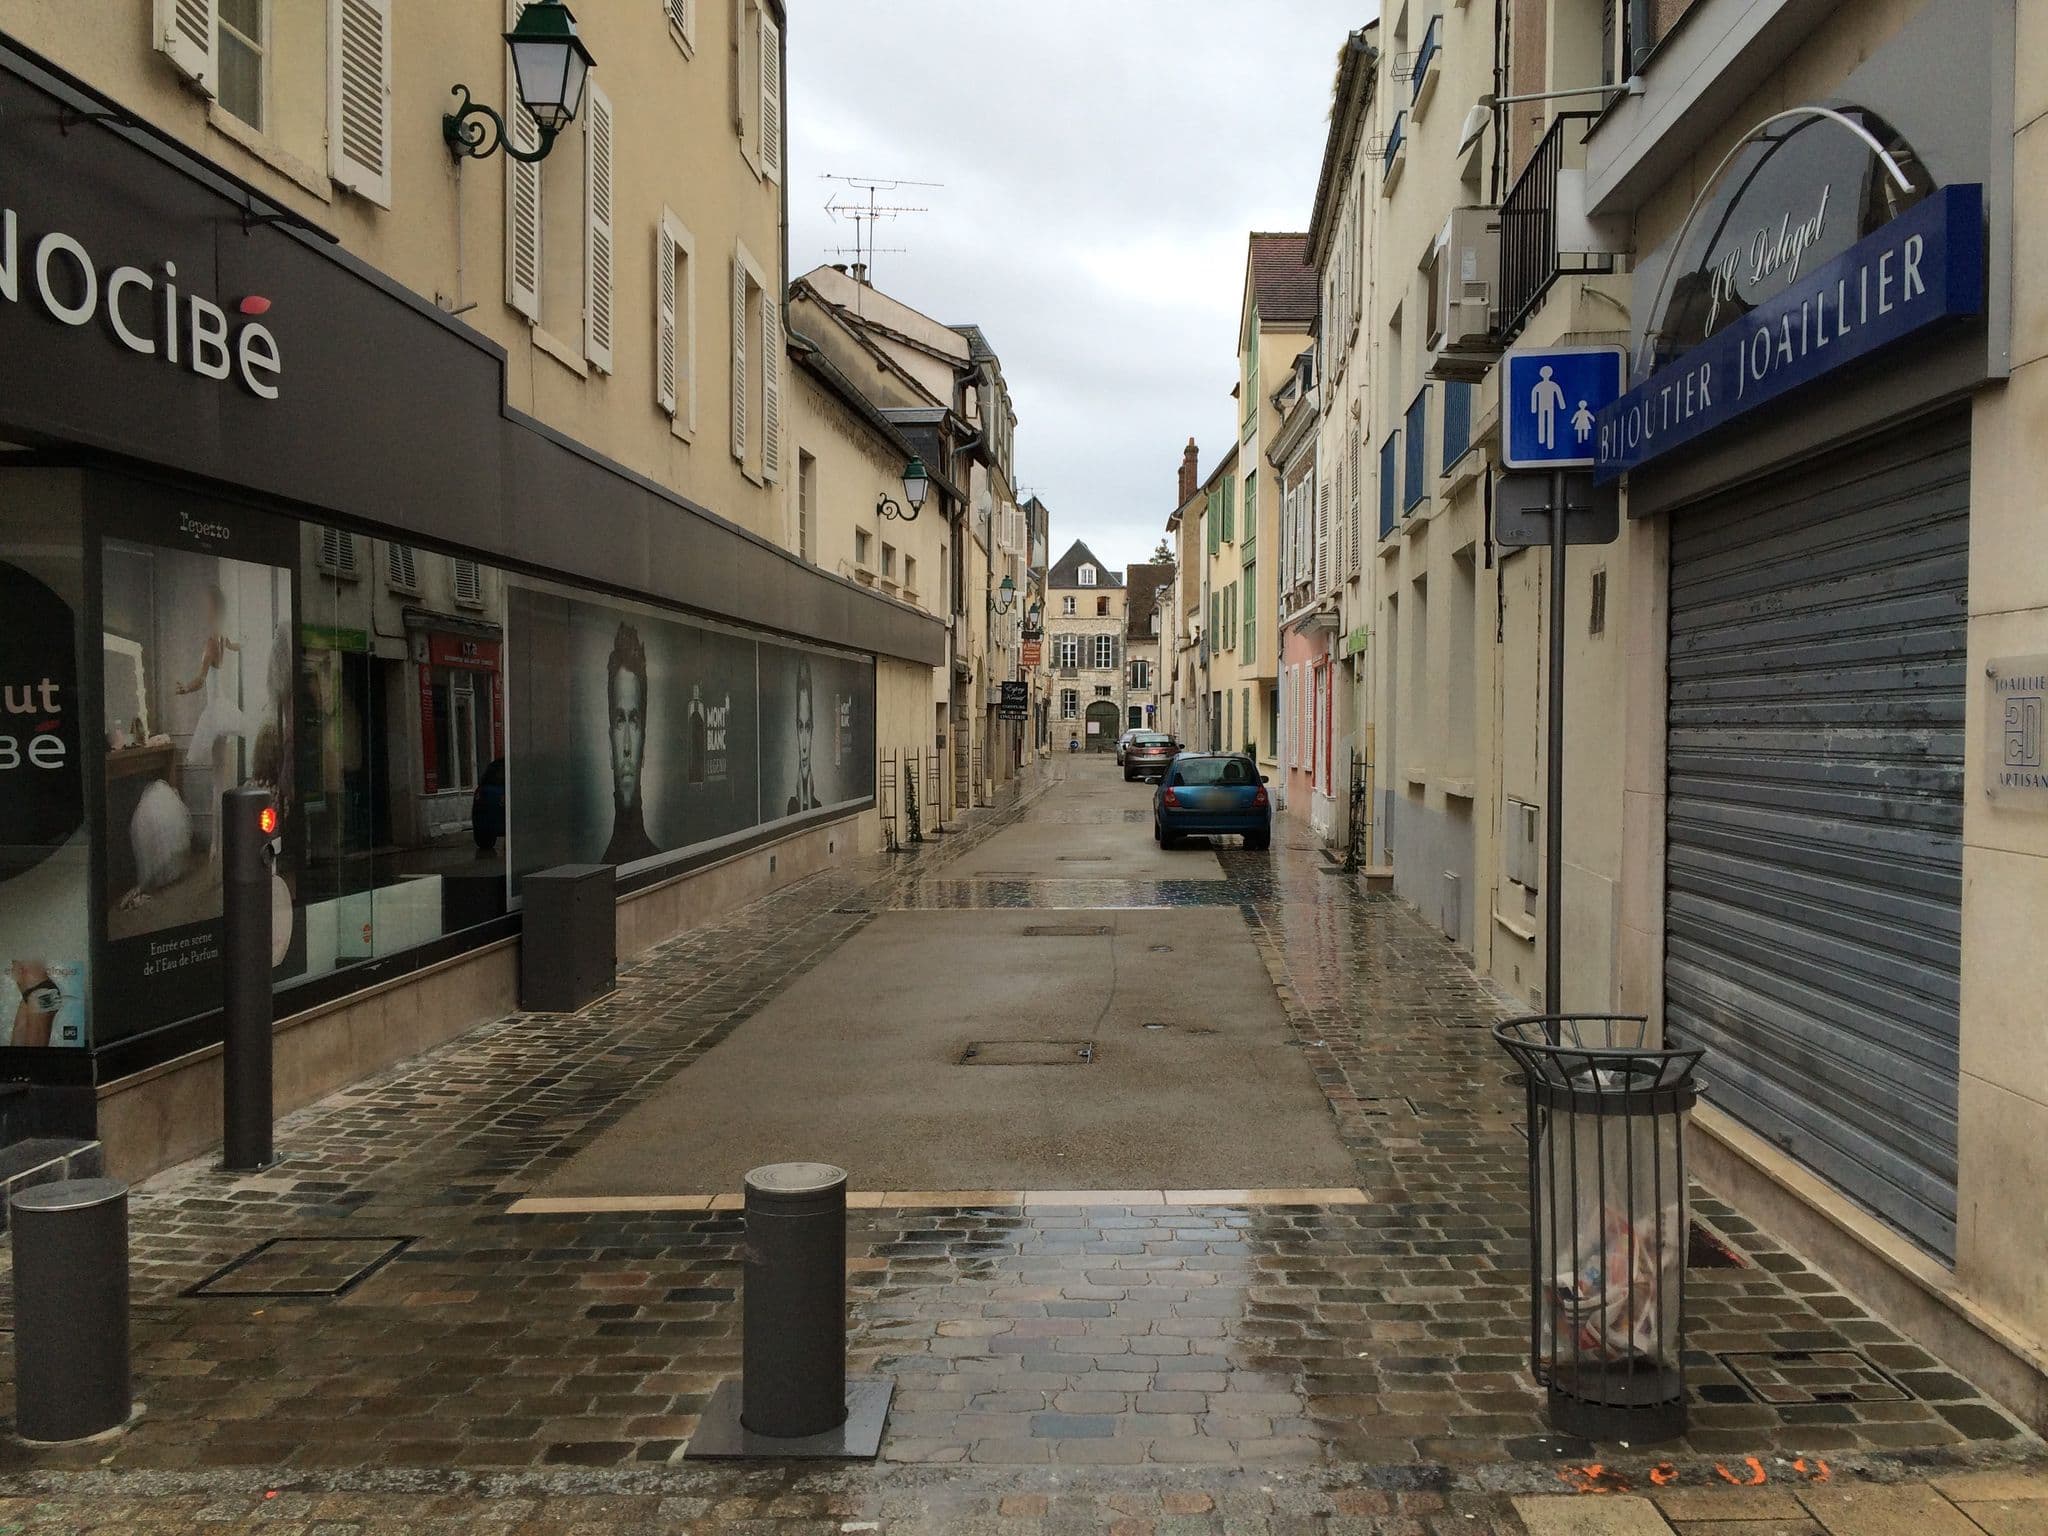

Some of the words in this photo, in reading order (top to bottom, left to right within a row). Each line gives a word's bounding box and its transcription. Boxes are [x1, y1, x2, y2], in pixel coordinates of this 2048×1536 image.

[1600, 361, 1712, 464] BIJOUTIER
[1738, 233, 1927, 400] JOAILLIER
[143, 962, 155, 976] de
[179, 953, 190, 967] de
[191, 947, 218, 964] Parfum
[150, 940, 178, 956] Entrée
[179, 938, 190, 948] en
